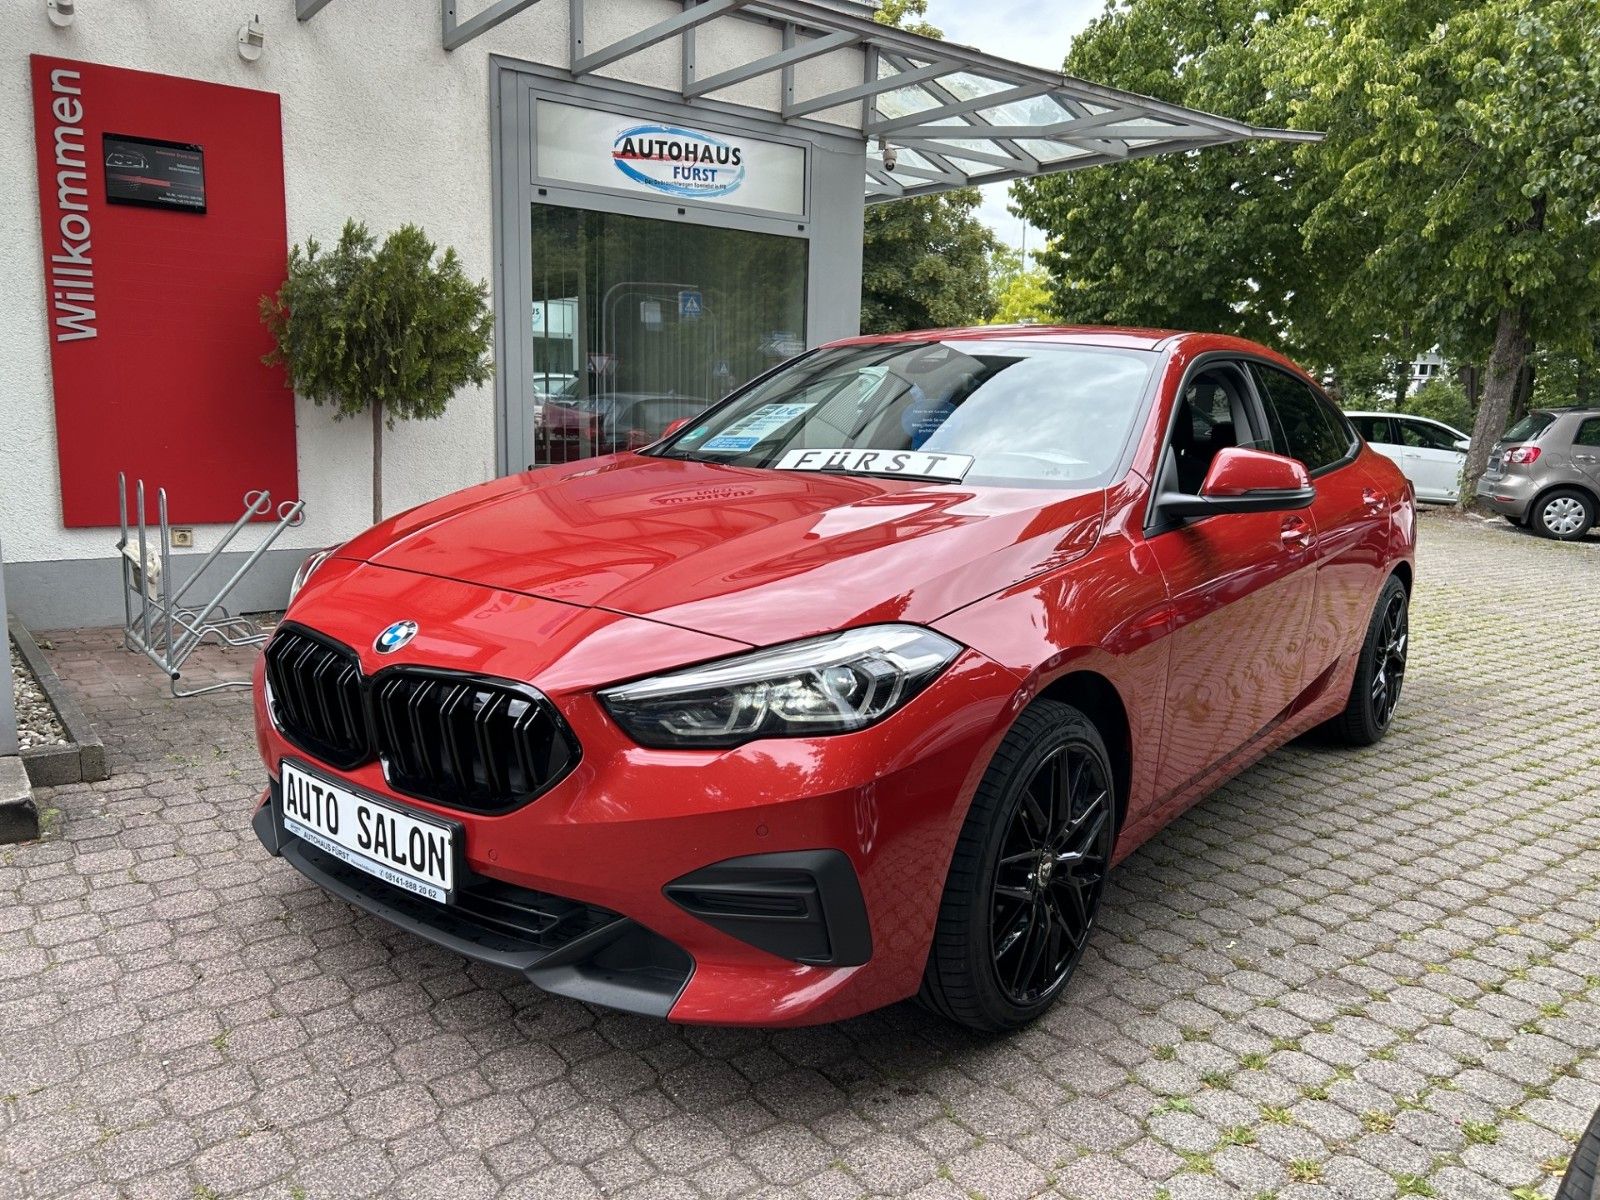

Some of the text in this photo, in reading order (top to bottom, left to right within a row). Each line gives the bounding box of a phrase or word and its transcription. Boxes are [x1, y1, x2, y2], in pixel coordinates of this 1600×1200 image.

[621, 137, 741, 166] AUTOHAUS
[50, 68, 97, 342] Willkommen
[793, 451, 947, 475] FÜRST
[287, 772, 446, 882] AUTO SALON
[303, 831, 332, 852] AUTOHAUS
[385, 871, 417, 891] 08141-888
[419, 885, 427, 895] 20
[428, 889, 437, 899] 62
